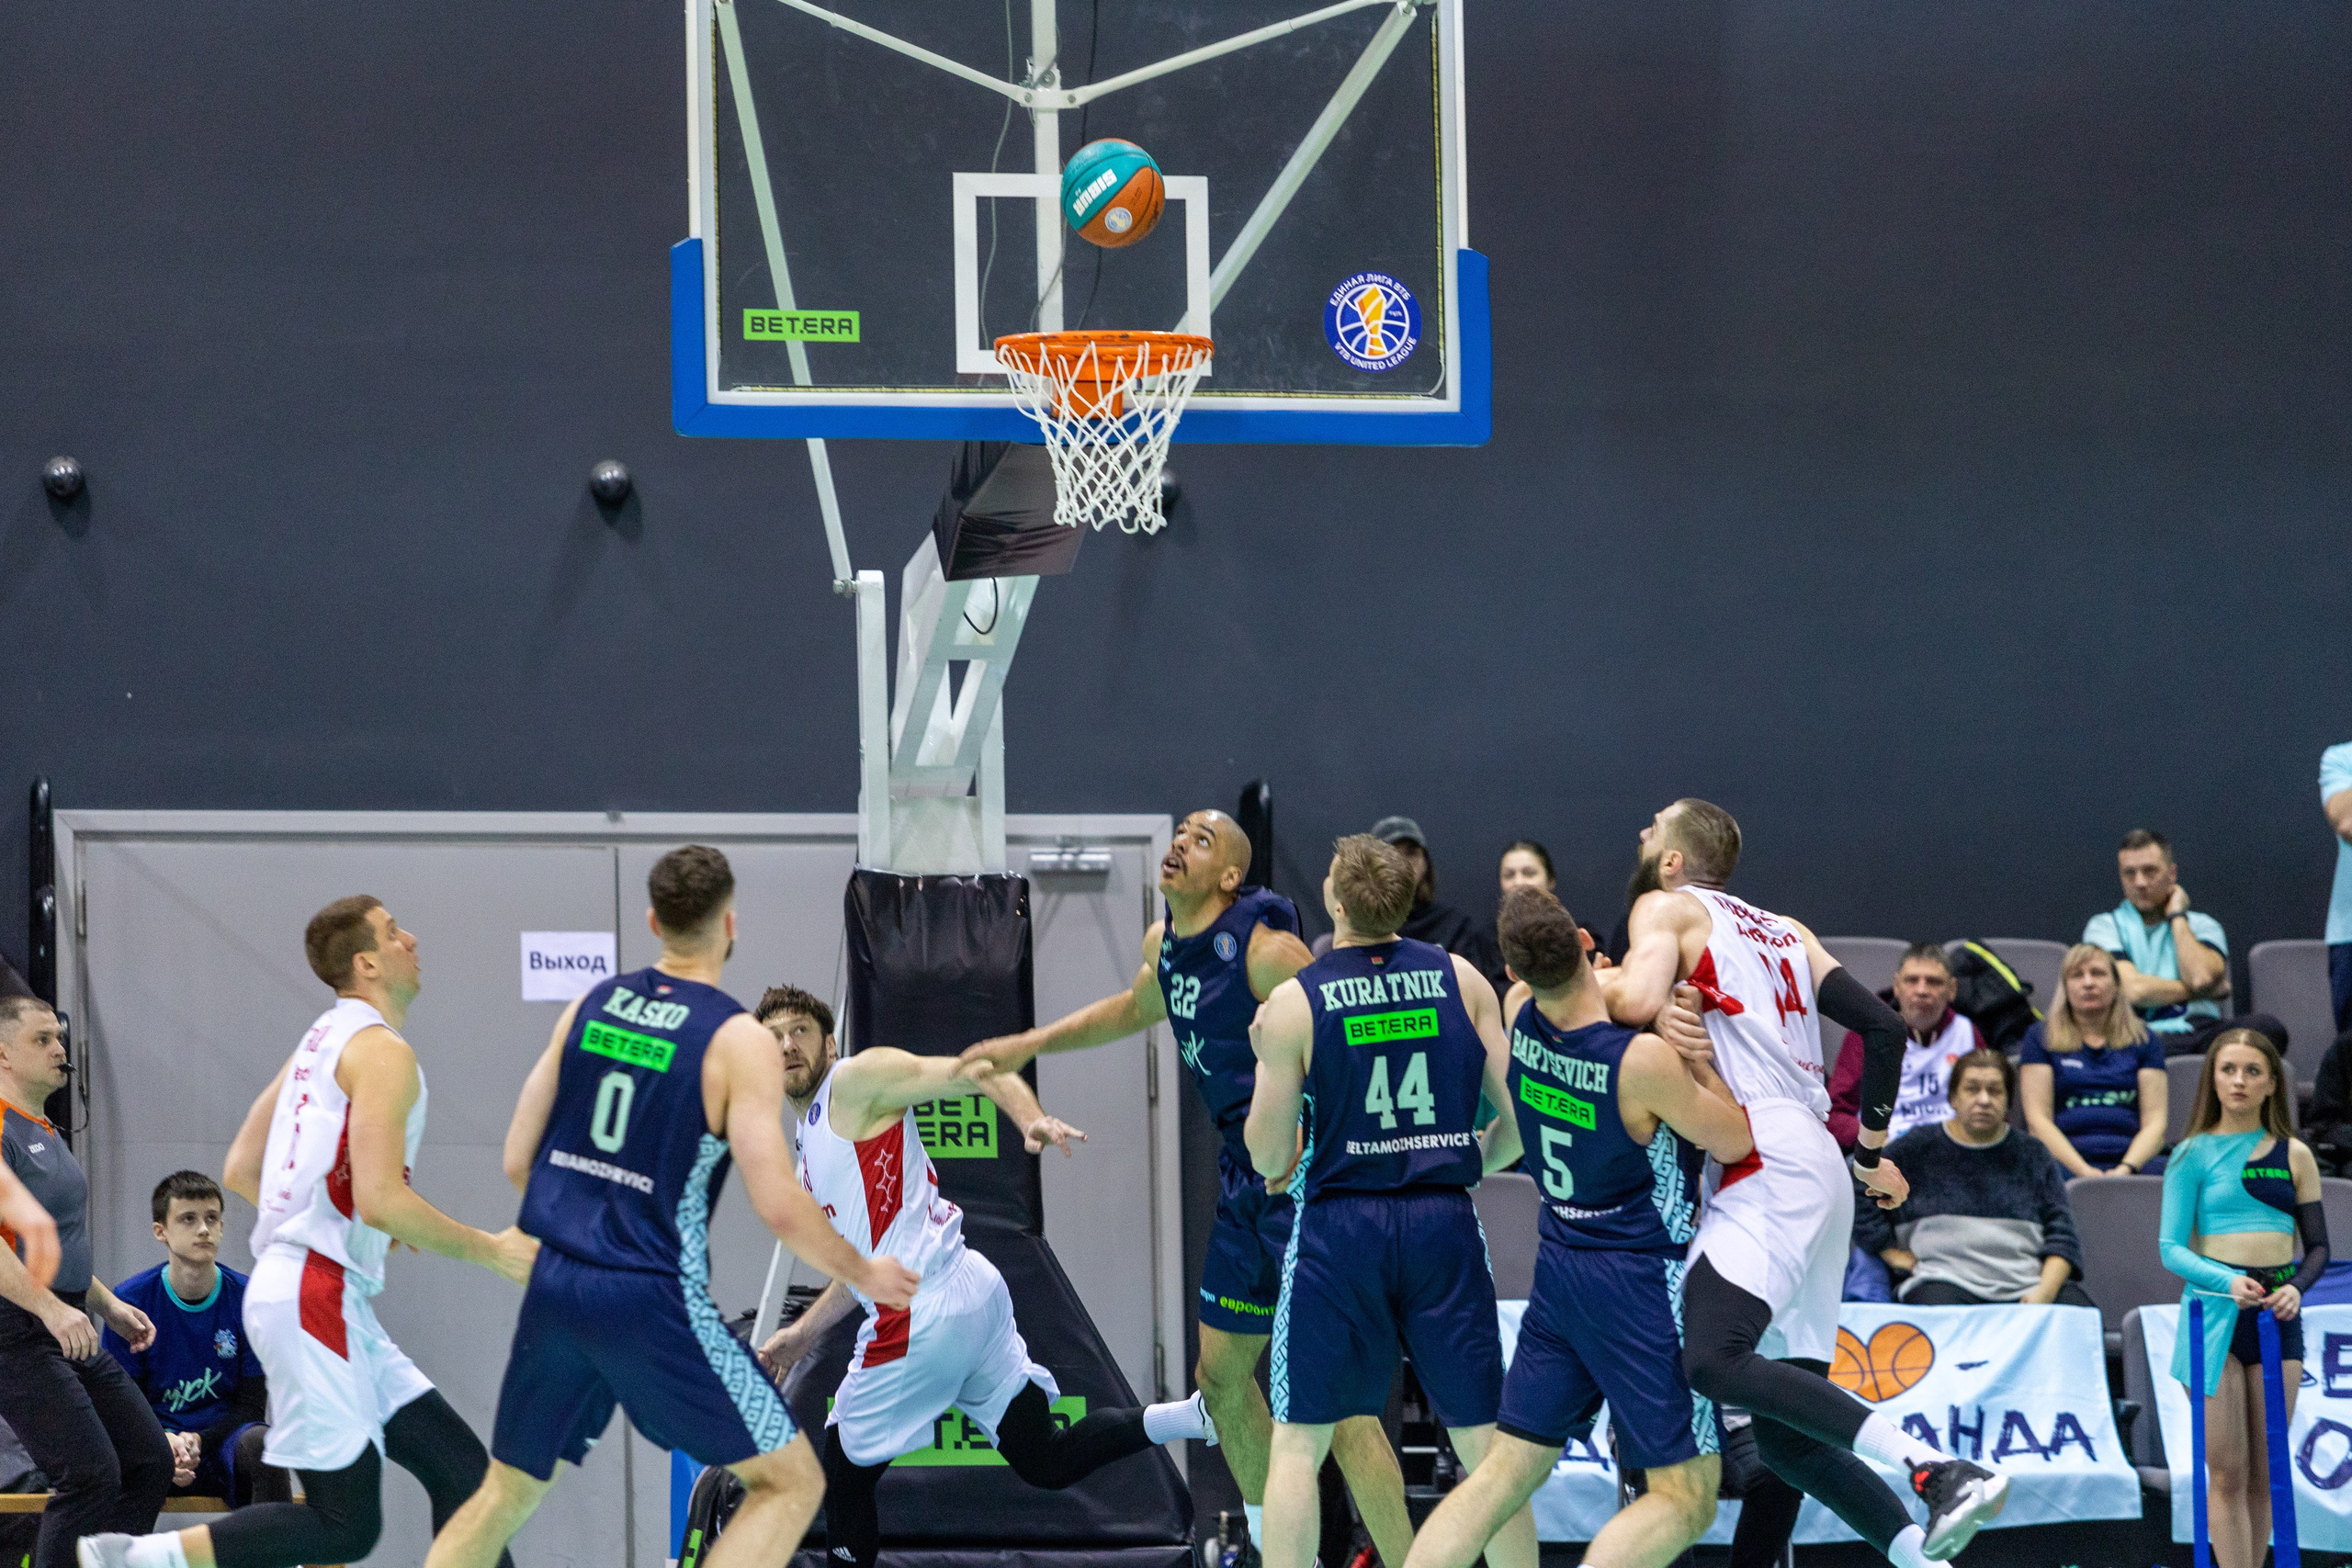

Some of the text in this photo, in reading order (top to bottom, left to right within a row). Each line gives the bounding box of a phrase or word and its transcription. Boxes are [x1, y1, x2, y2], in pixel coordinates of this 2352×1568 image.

[1072, 168, 1118, 217] SIBUR
[1329, 273, 1412, 307] ЕДИНАЯ ЛИГА ВТБ
[751, 316, 853, 335] BET.ERA
[1334, 336, 1418, 371] VTB UNITED LEAGUE
[529, 951, 607, 974] Выход
[602, 986, 690, 1031] KASKO
[1170, 972, 1201, 1021] 22
[1318, 969, 1448, 1011] KURATNIK
[1511, 1028, 1610, 1094] BARTSEVICH
[590, 1070, 636, 1154] 0
[1365, 1051, 1437, 1131] 44
[919, 1121, 989, 1147] ERA
[1540, 1123, 1575, 1201] 5
